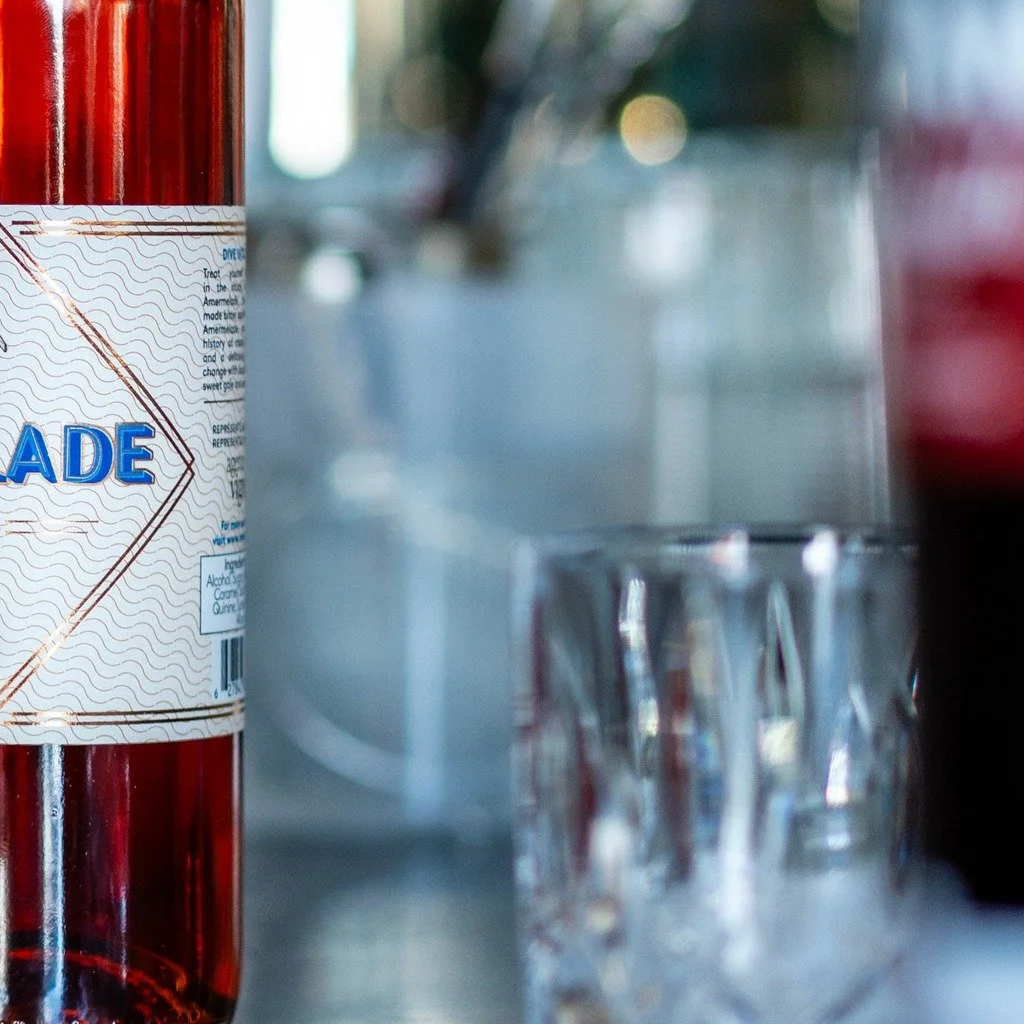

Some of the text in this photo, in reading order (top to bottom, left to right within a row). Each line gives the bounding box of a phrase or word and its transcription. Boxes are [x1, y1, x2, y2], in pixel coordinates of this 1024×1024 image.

[203, 268, 220, 279] Treat
[203, 282, 210, 292] in
[203, 310, 222, 321] made
[203, 338, 225, 351] history
[203, 353, 216, 363] and
[203, 366, 227, 379] change
[203, 381, 223, 391] sweet
